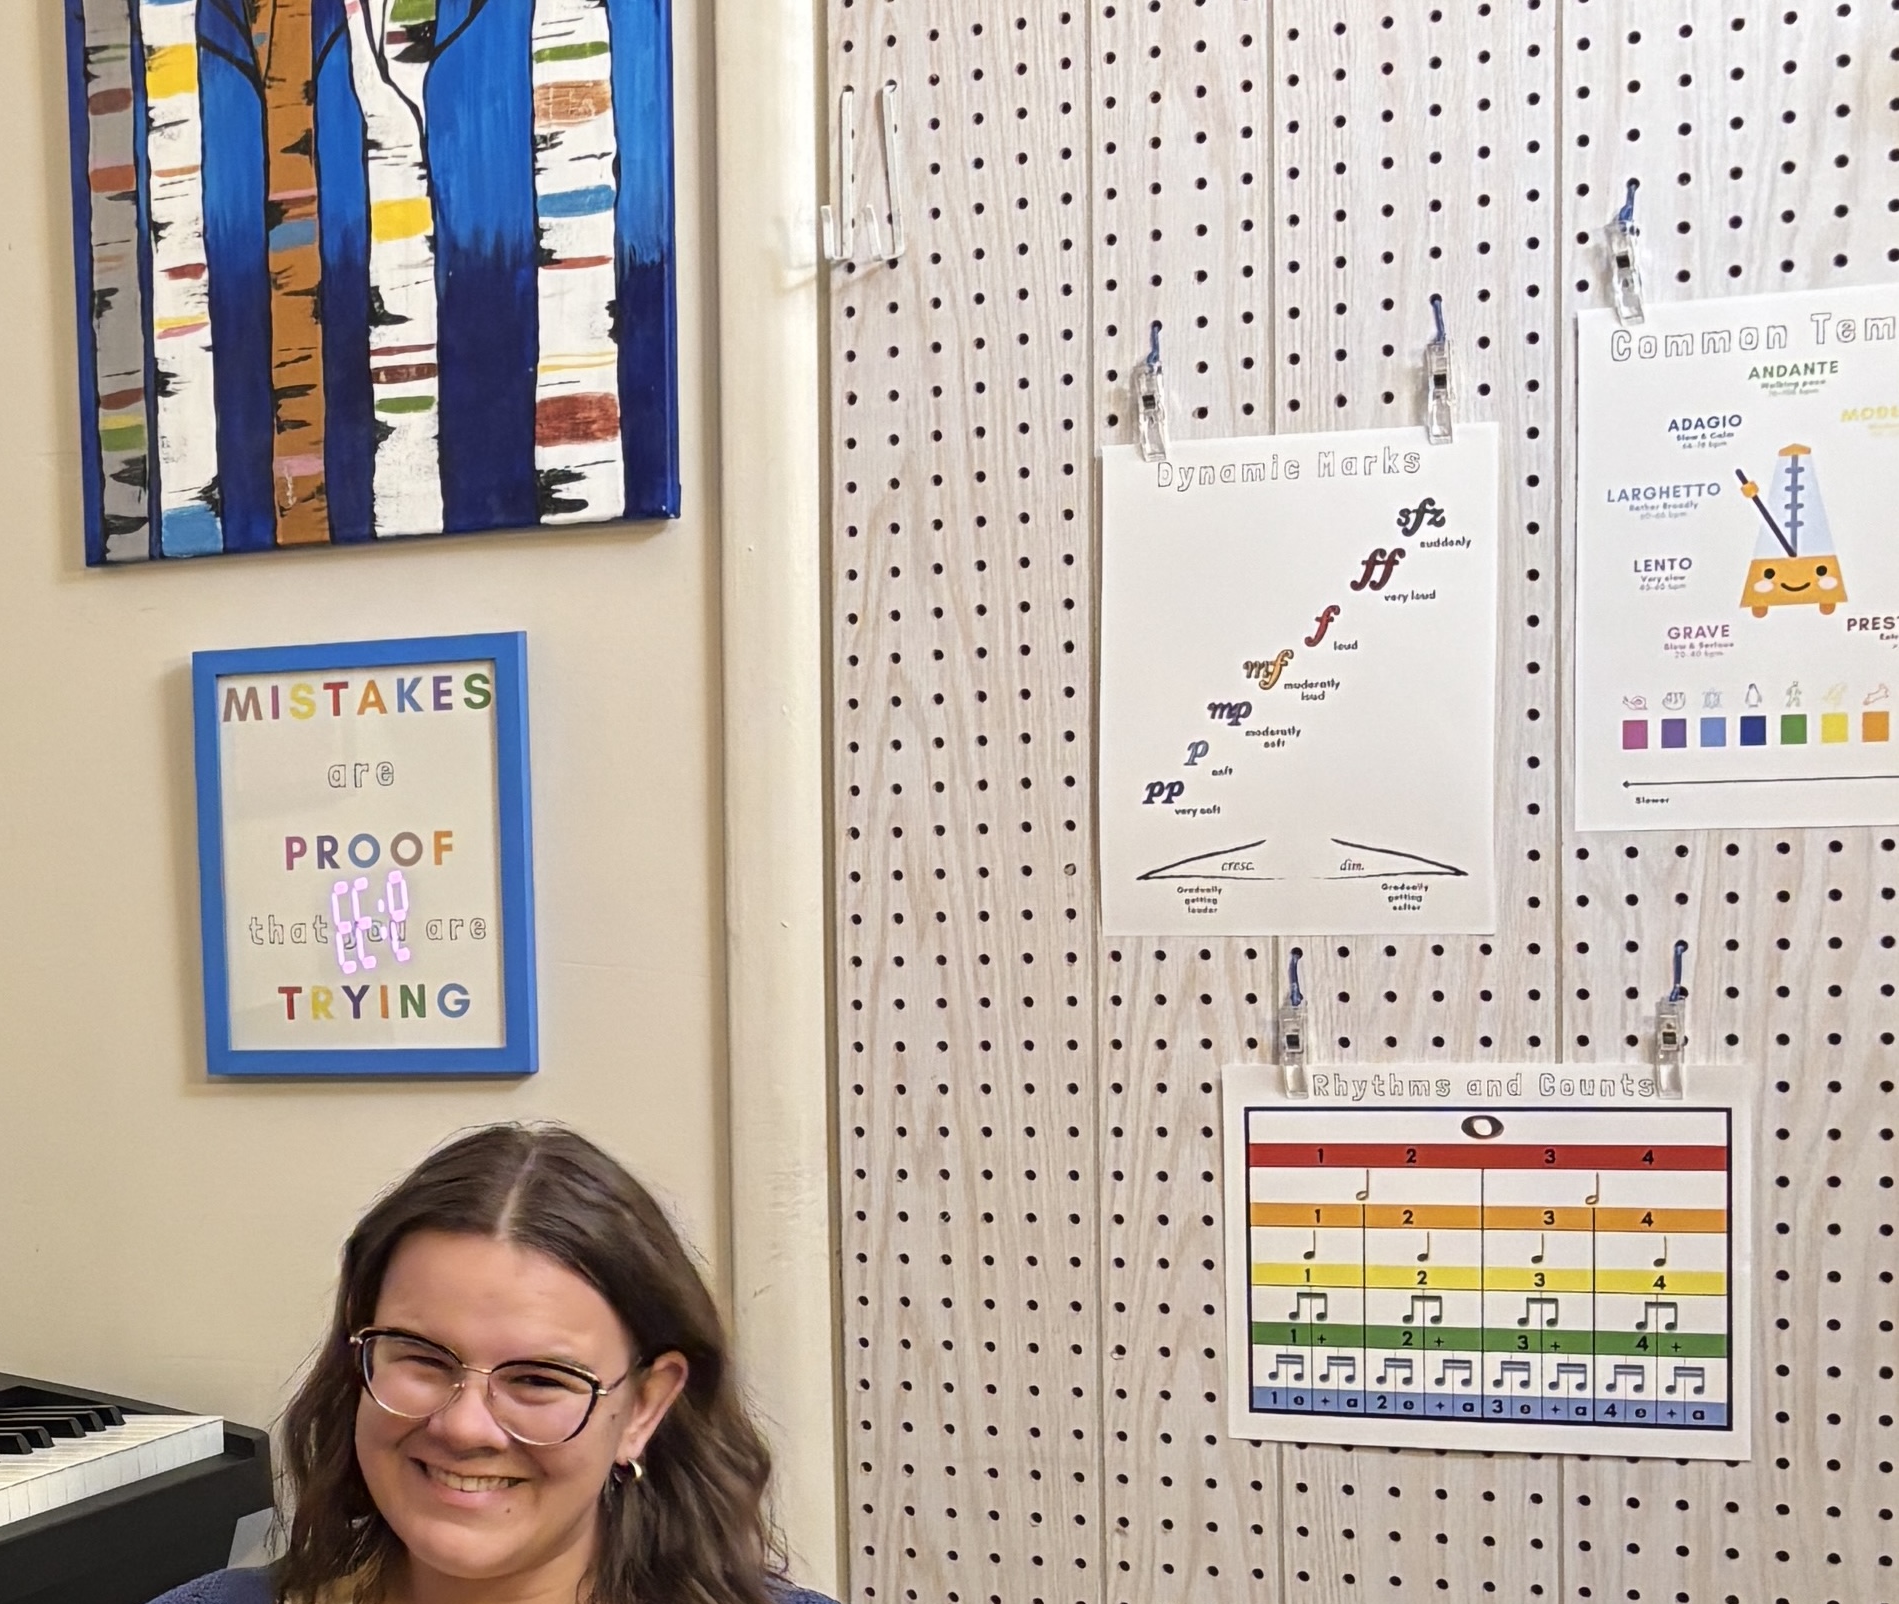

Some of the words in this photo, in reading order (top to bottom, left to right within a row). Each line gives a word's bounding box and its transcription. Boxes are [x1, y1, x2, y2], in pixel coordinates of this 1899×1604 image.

[1610, 324, 1788, 362] Common
[1810, 311, 1897, 345] Tem
[1747, 359, 1839, 381] ANDANTE
[1667, 414, 1743, 433] ADAGIO
[1676, 434, 1699, 442] Slow
[1157, 453, 1301, 493] Dynamic
[1317, 445, 1422, 479] Marks
[1606, 482, 1722, 503] LARGHETTO
[1396, 497, 1447, 538] sfz
[1349, 547, 1407, 592] ff
[1633, 557, 1693, 573] LENTO
[1640, 575, 1662, 584] Very
[1383, 593, 1409, 604] very
[1410, 589, 1437, 601] loud
[1667, 624, 1730, 640] GRAVE
[1847, 615, 1899, 632] PRES
[1333, 639, 1359, 651] loud
[1663, 643, 1687, 651] Slow
[1242, 648, 1295, 691] mf
[221, 672, 493, 723] MISTAKES
[1300, 690, 1326, 701] loud
[1206, 700, 1253, 727] mp
[1263, 738, 1286, 749] soft
[326, 760, 396, 790] are
[1141, 780, 1185, 805] pp
[1635, 796, 1670, 805] Slower
[1174, 807, 1198, 818] very
[1199, 804, 1221, 815] soft
[284, 830, 454, 872] PROOF
[1339, 857, 1365, 872] dim.
[1176, 885, 1223, 896] Gradually
[1380, 882, 1429, 893] Gradually
[1184, 896, 1218, 905] getting
[1387, 893, 1423, 903] getting
[1187, 905, 1218, 914] louder
[248, 914, 329, 947] that
[424, 916, 488, 943] are
[276, 982, 472, 1021] TRYING
[1311, 1072, 1452, 1102] Rhythms
[1466, 1072, 1524, 1097] and
[1538, 1072, 1656, 1098] Counts
[1316, 1148, 1324, 1164] 1
[1406, 1148, 1417, 1164] 2
[1544, 1148, 1556, 1164] 3
[1641, 1149, 1655, 1166] 4
[1313, 1208, 1321, 1224] 1
[1402, 1209, 1414, 1225] 2
[1543, 1210, 1555, 1226] 3
[1640, 1211, 1654, 1228] 4
[1304, 1268, 1311, 1283] 1
[1416, 1270, 1428, 1285] 2
[1533, 1272, 1546, 1288] 3
[1652, 1275, 1667, 1291] 4
[1289, 1328, 1297, 1344] 1
[1402, 1330, 1413, 1347] 2
[1517, 1334, 1529, 1351] 3
[1635, 1335, 1649, 1352] 4
[1270, 1390, 1278, 1405] 1
[1376, 1394, 1388, 1410] 2
[1492, 1399, 1504, 1414] 3
[1603, 1402, 1618, 1418] 4
